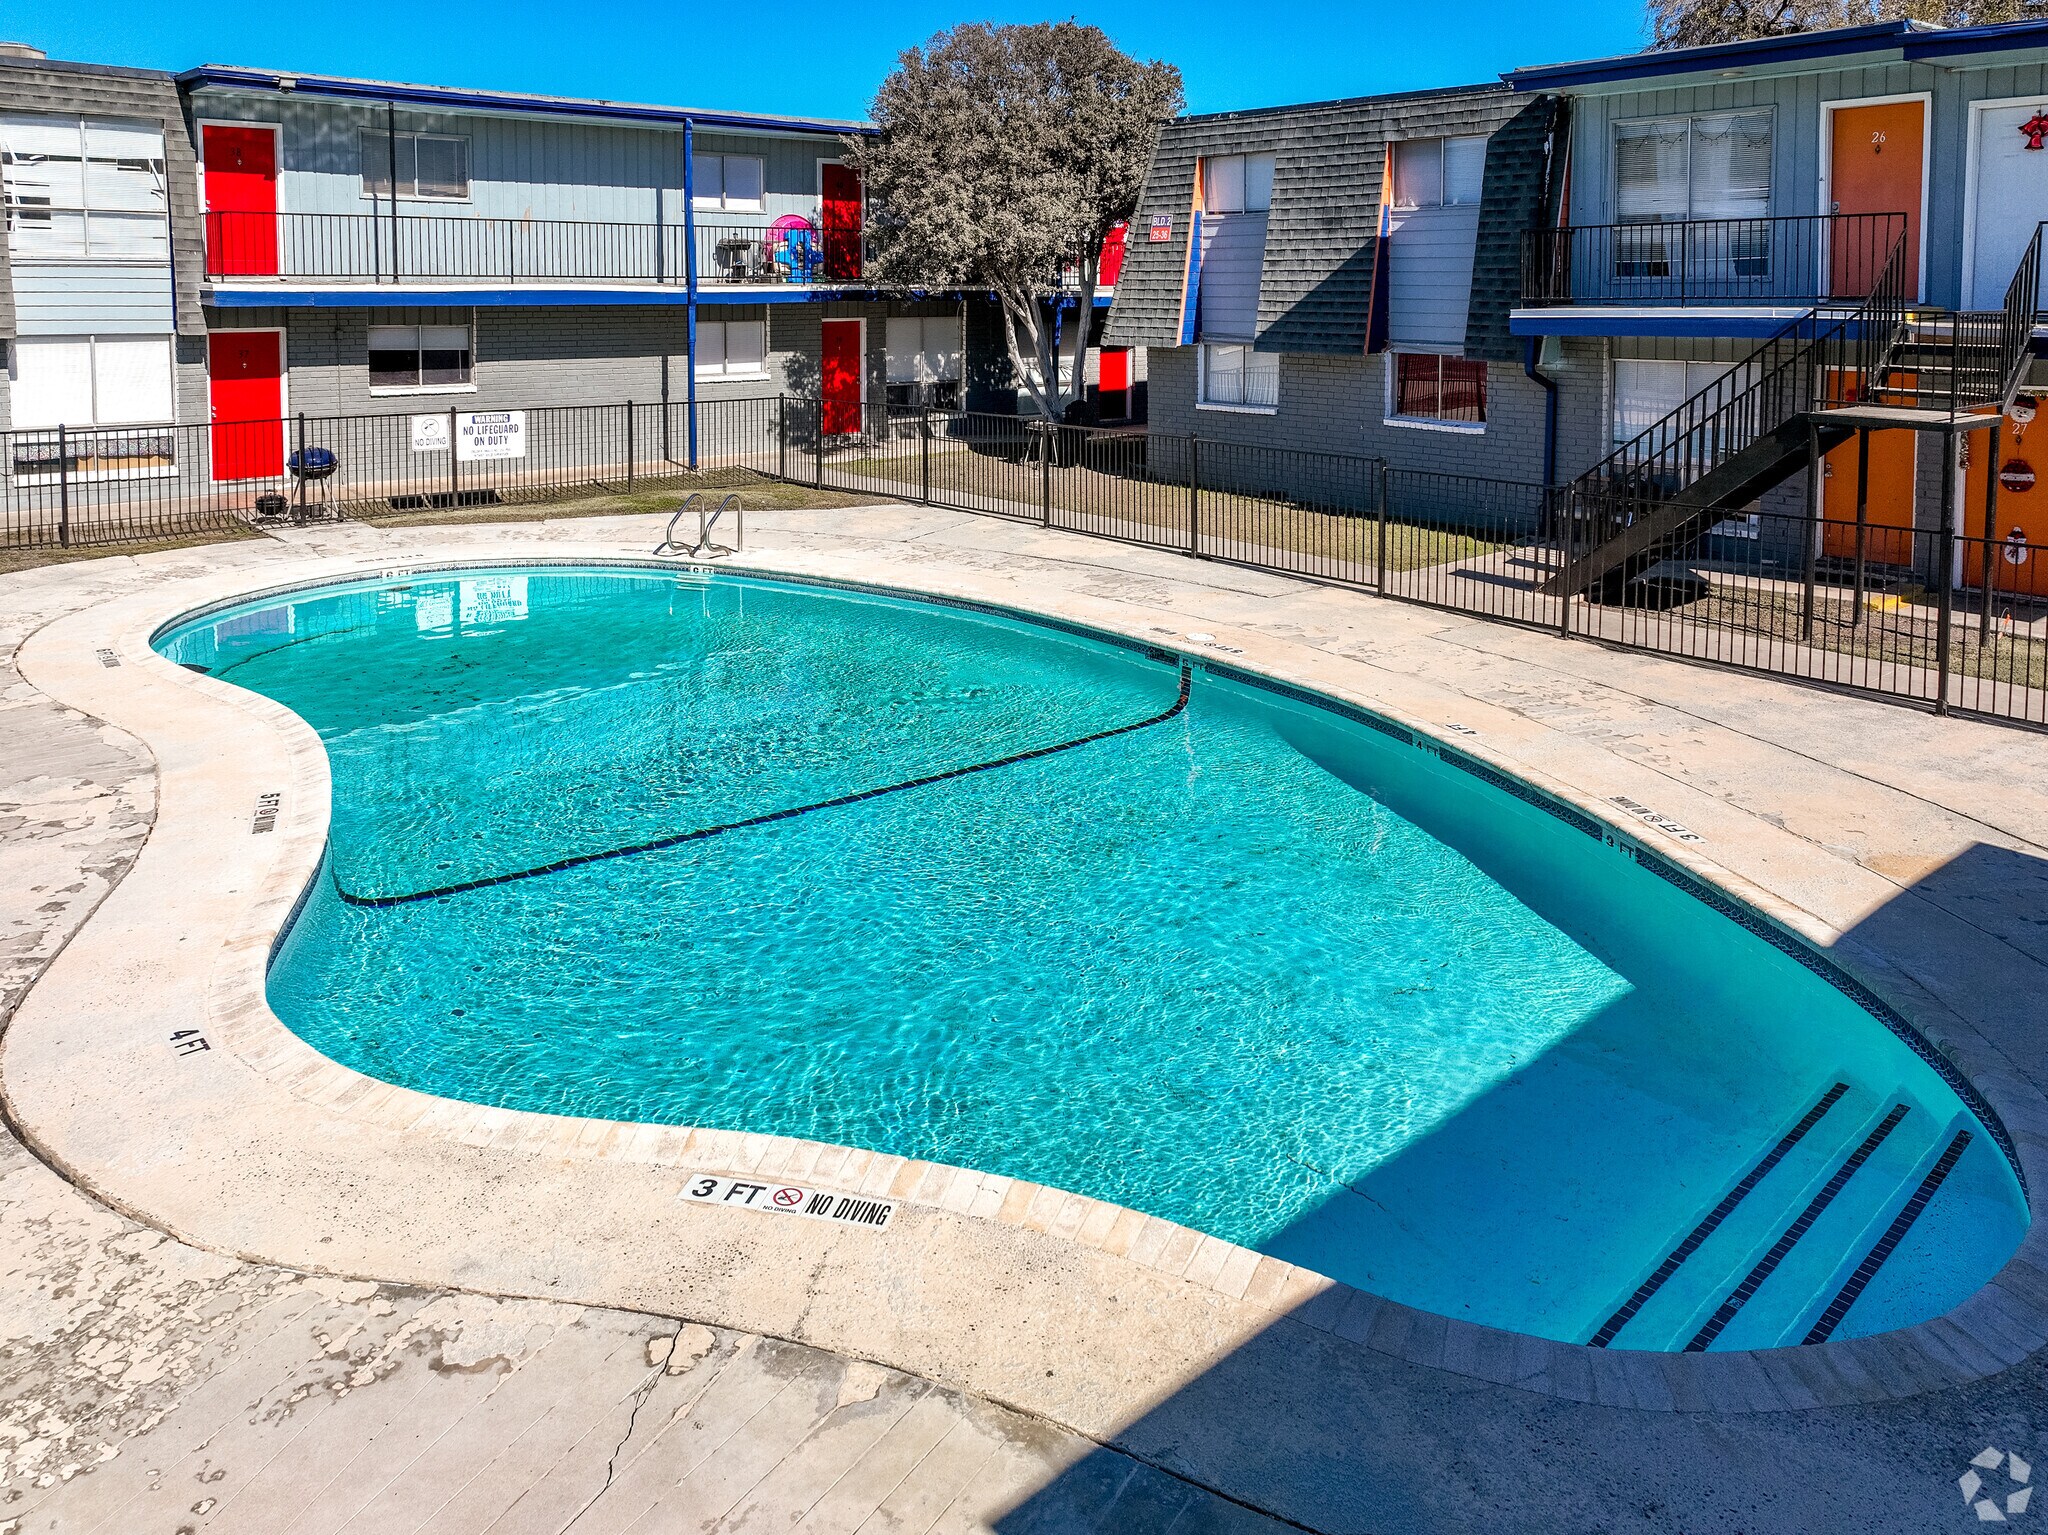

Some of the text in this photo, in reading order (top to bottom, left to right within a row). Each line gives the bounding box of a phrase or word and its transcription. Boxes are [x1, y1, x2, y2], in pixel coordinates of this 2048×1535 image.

[1871, 131, 1886, 143] 26
[473, 414, 509, 424] WARNING
[463, 424, 519, 436] NO LIFEGUARD
[2012, 423, 2028, 435] 27
[414, 437, 447, 446] NO DIVING
[474, 435, 509, 446] ON DUTY
[1416, 740, 1438, 757] 4 FT
[258, 799, 279, 808] FT
[1658, 824, 1686, 833] FT
[1606, 835, 1634, 858] 3 FT
[170, 1029, 211, 1056] 4 FT
[691, 1179, 892, 1226] 3 FT NO DIVING
